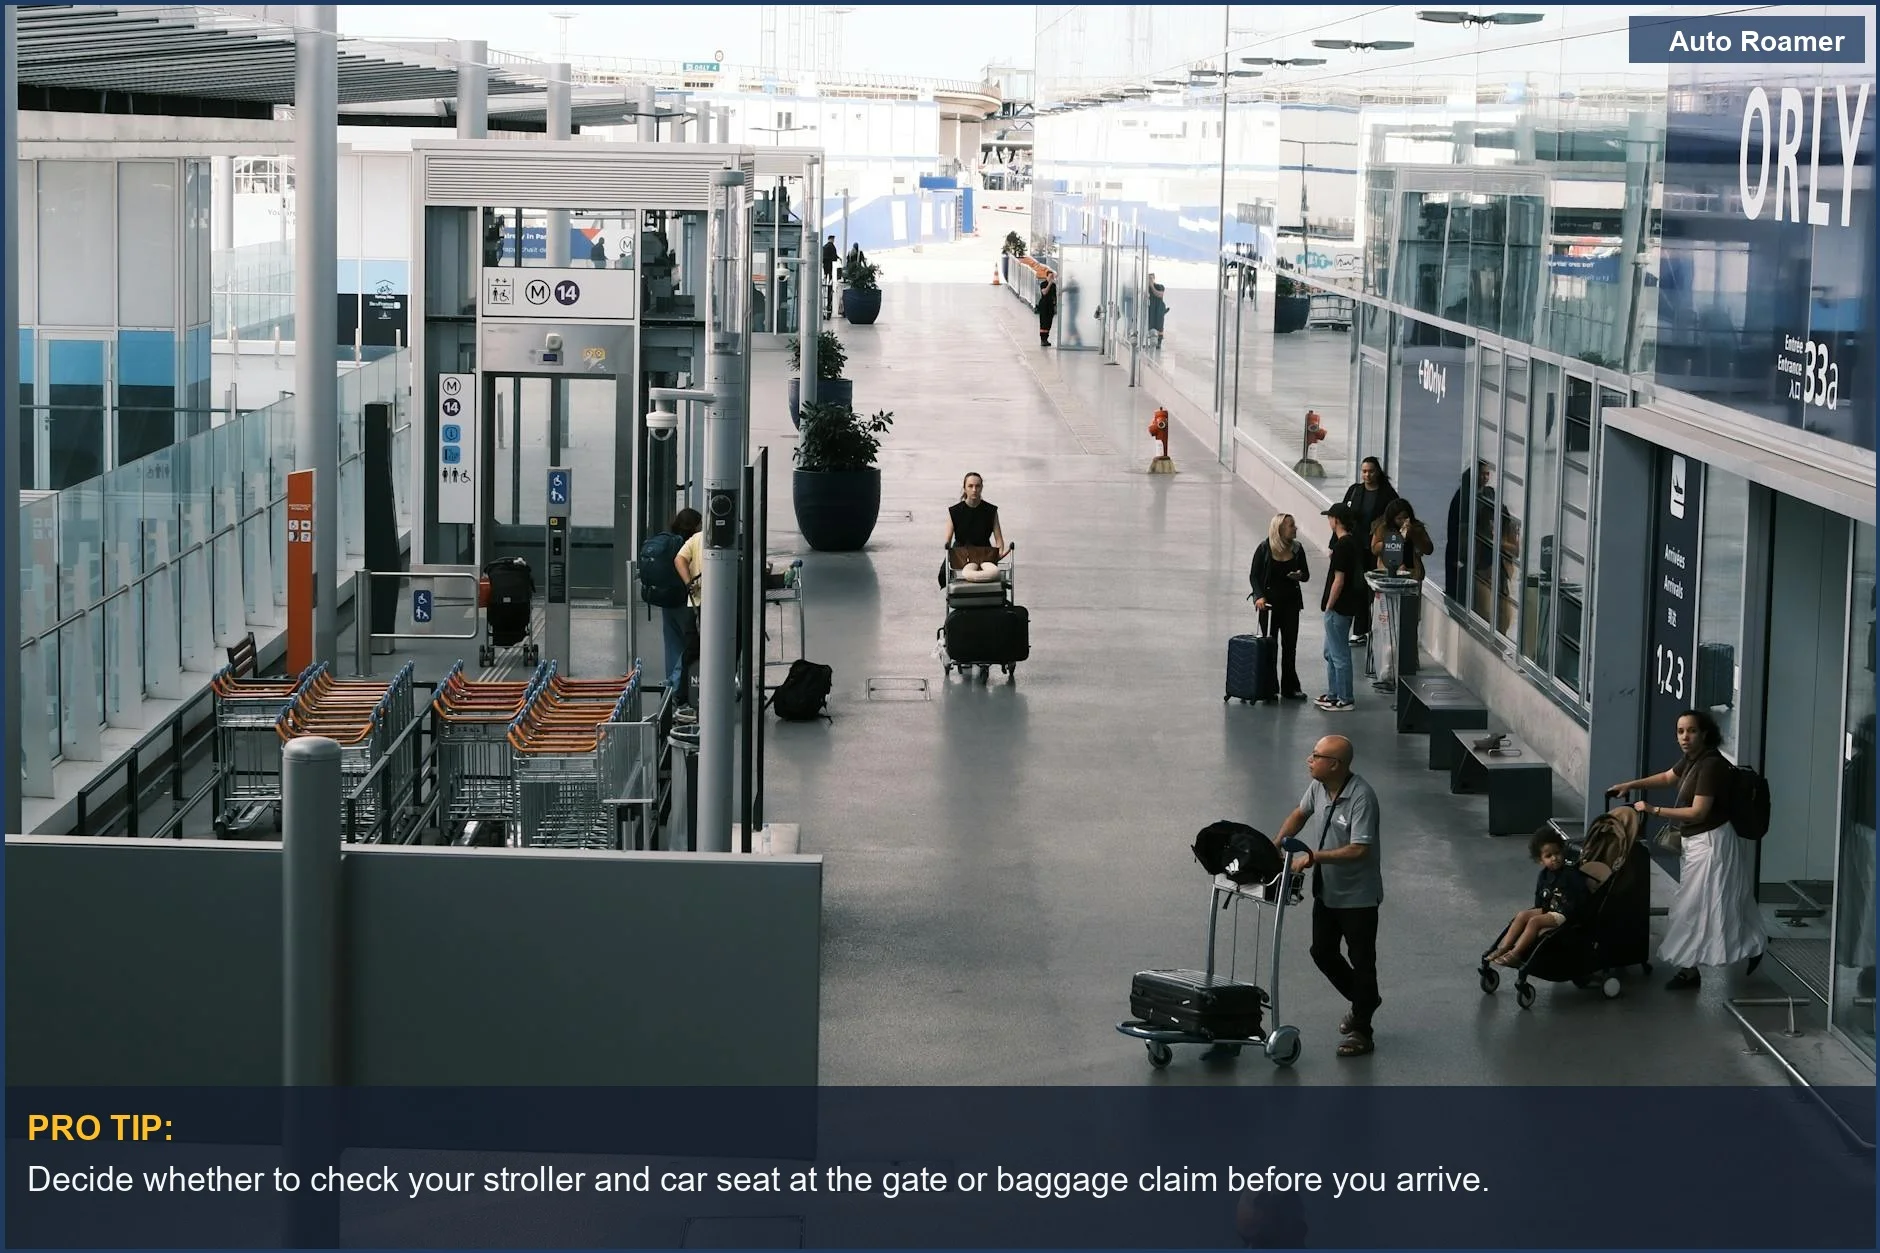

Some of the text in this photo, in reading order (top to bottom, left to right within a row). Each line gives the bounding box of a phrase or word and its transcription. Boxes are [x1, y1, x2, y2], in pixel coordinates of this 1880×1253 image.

[1739, 83, 1870, 227] ORLY
[531, 285, 577, 301] M 14
[1785, 334, 1804, 354] Entrée
[1777, 354, 1803, 376] Entrance
[446, 381, 457, 391] M
[1788, 379, 1801, 401] 入口
[444, 401, 459, 413] 14
[1664, 544, 1686, 569] Arrivées
[1663, 575, 1684, 600] Arrivals
